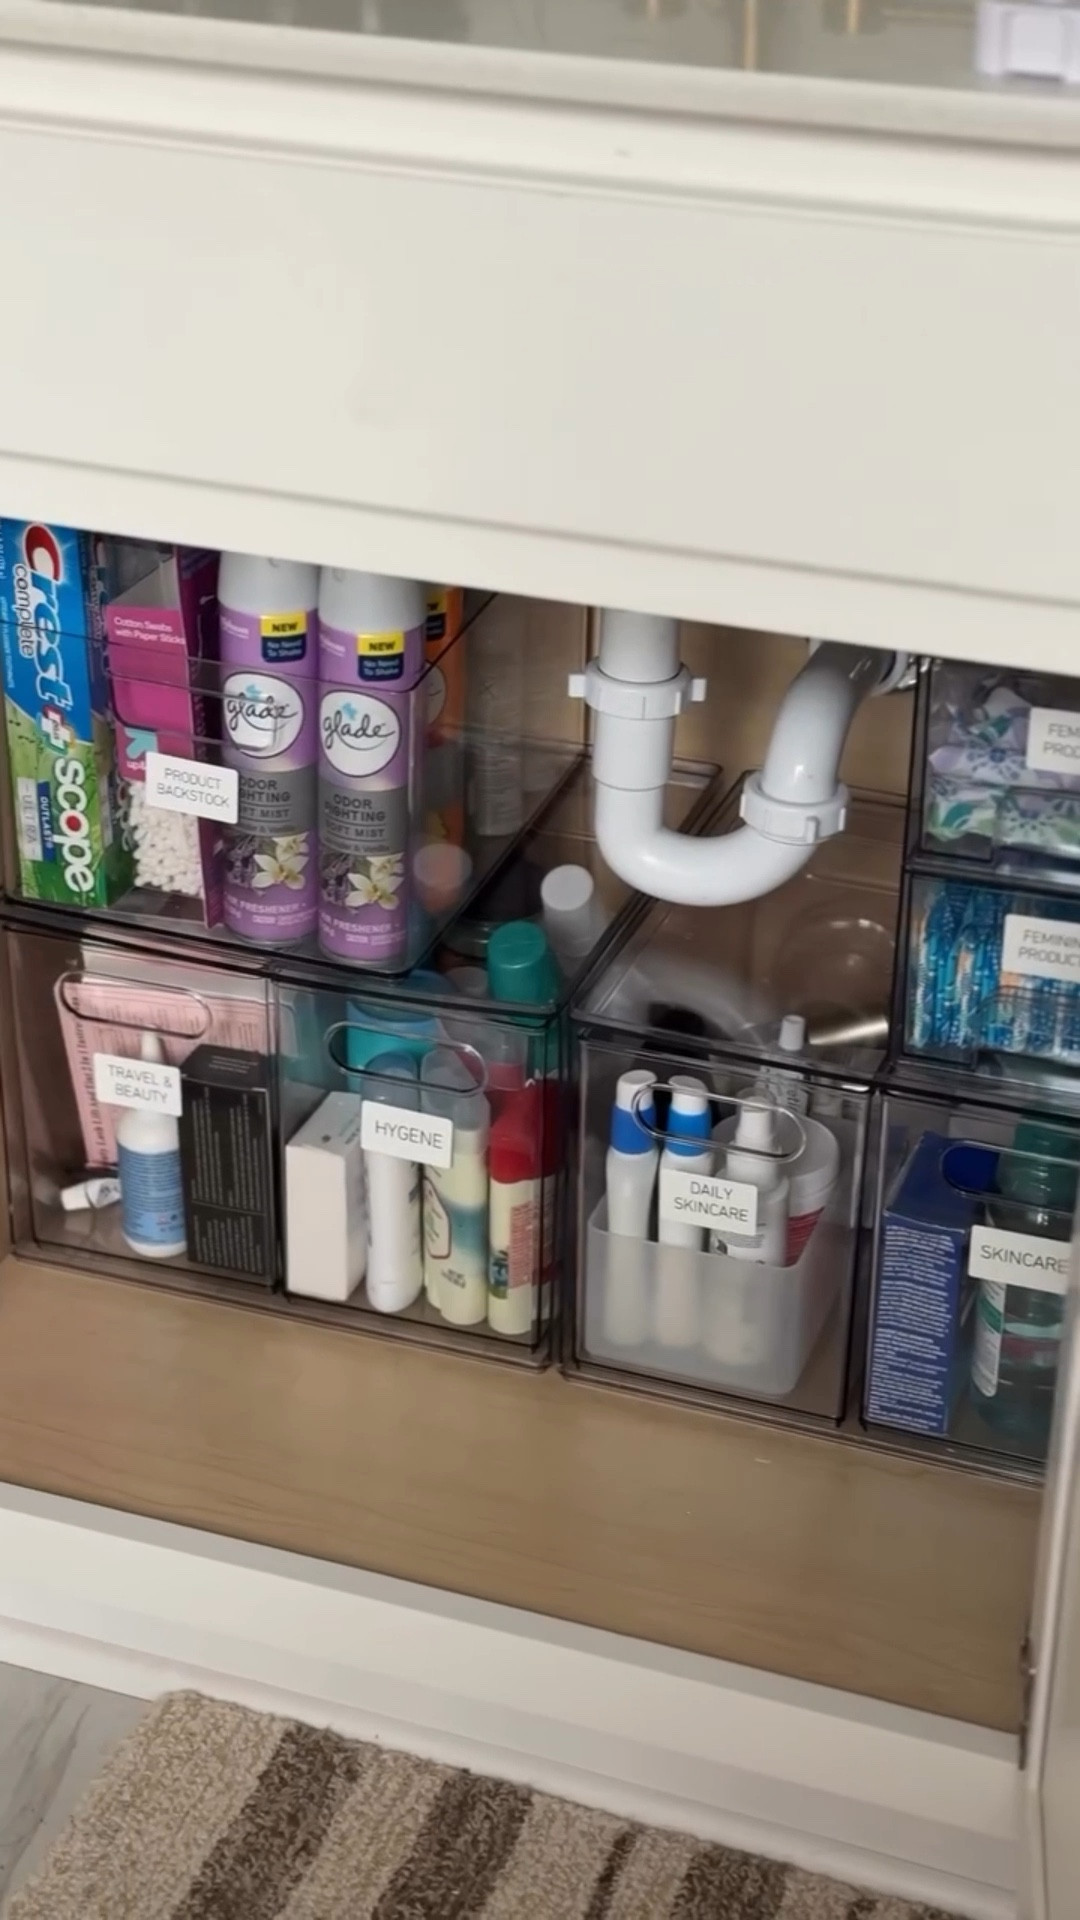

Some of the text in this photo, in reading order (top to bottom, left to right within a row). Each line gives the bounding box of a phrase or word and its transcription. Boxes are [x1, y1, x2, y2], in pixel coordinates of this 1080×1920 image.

[13, 564, 34, 658] complete
[23, 523, 73, 707] Crest
[114, 616, 173, 633] Cotton Swabs
[115, 629, 186, 645] with Paper Sticks
[271, 622, 298, 632] NEW
[368, 641, 396, 651] NEW
[227, 692, 298, 731] glade
[323, 710, 396, 749] glade
[164, 767, 222, 790] PRODUCT
[157, 782, 230, 808] BACKSTOCK
[333, 793, 373, 810] ODOR
[23, 793, 36, 844] ULTRA
[51, 758, 95, 893] scope
[355, 828, 385, 838] MIST
[107, 1064, 173, 1088] TRAVEL &
[115, 1082, 168, 1103] BEAUTY
[375, 1120, 443, 1149] HYGENE
[690, 1181, 733, 1200] DAILY
[674, 1196, 749, 1222] SKINCARE
[980, 1244, 1071, 1274] SKINCARE
